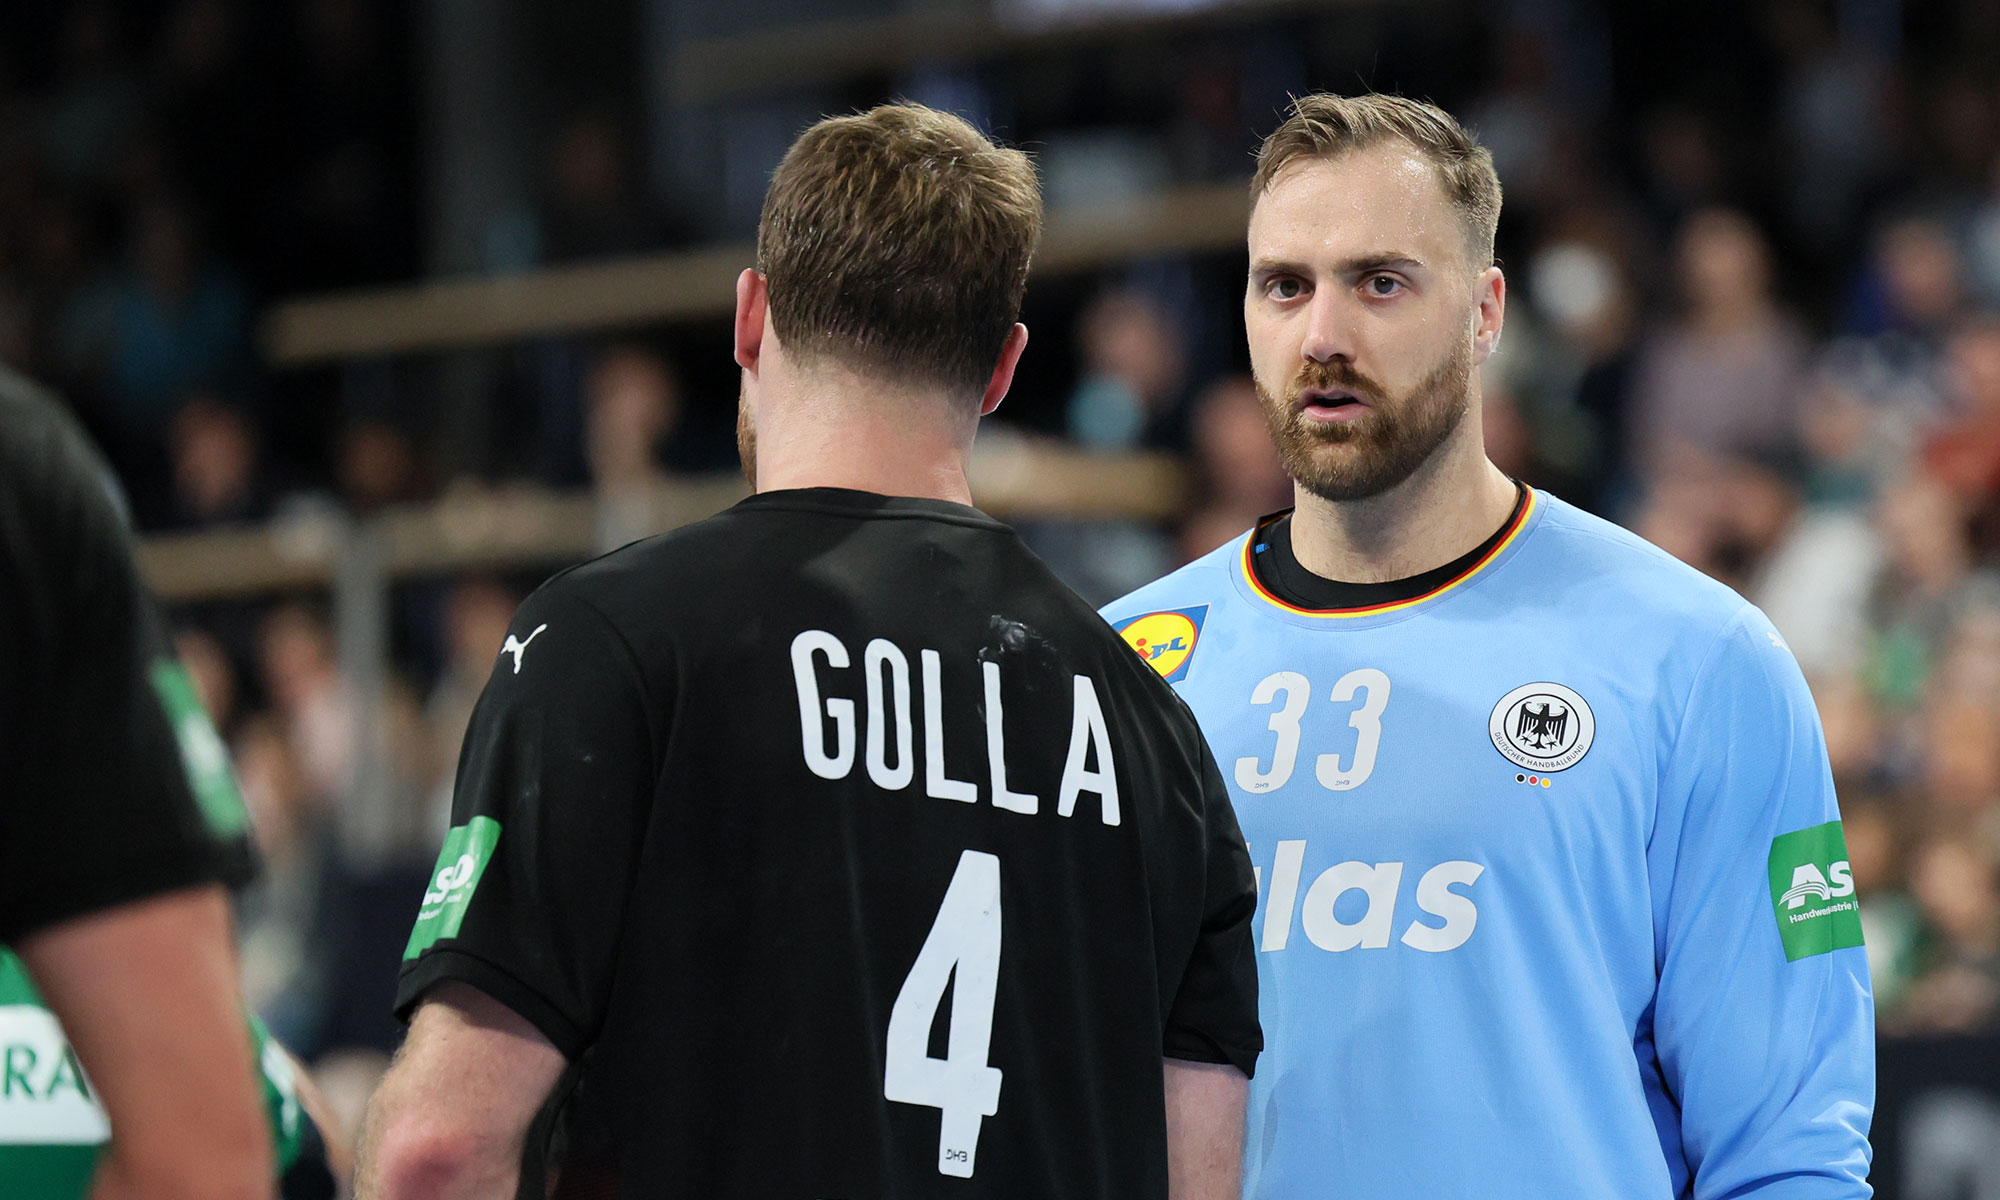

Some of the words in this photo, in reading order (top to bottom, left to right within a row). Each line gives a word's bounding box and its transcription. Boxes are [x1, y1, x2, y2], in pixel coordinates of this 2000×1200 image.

[790, 629, 1121, 827] GOLLA
[1233, 667, 1392, 795] 33
[1494, 731, 1526, 764] DEUTSCHER
[1526, 743, 1585, 769] HANDBALLBUND
[1246, 839, 1486, 953] las
[883, 849, 1003, 1178] 4
